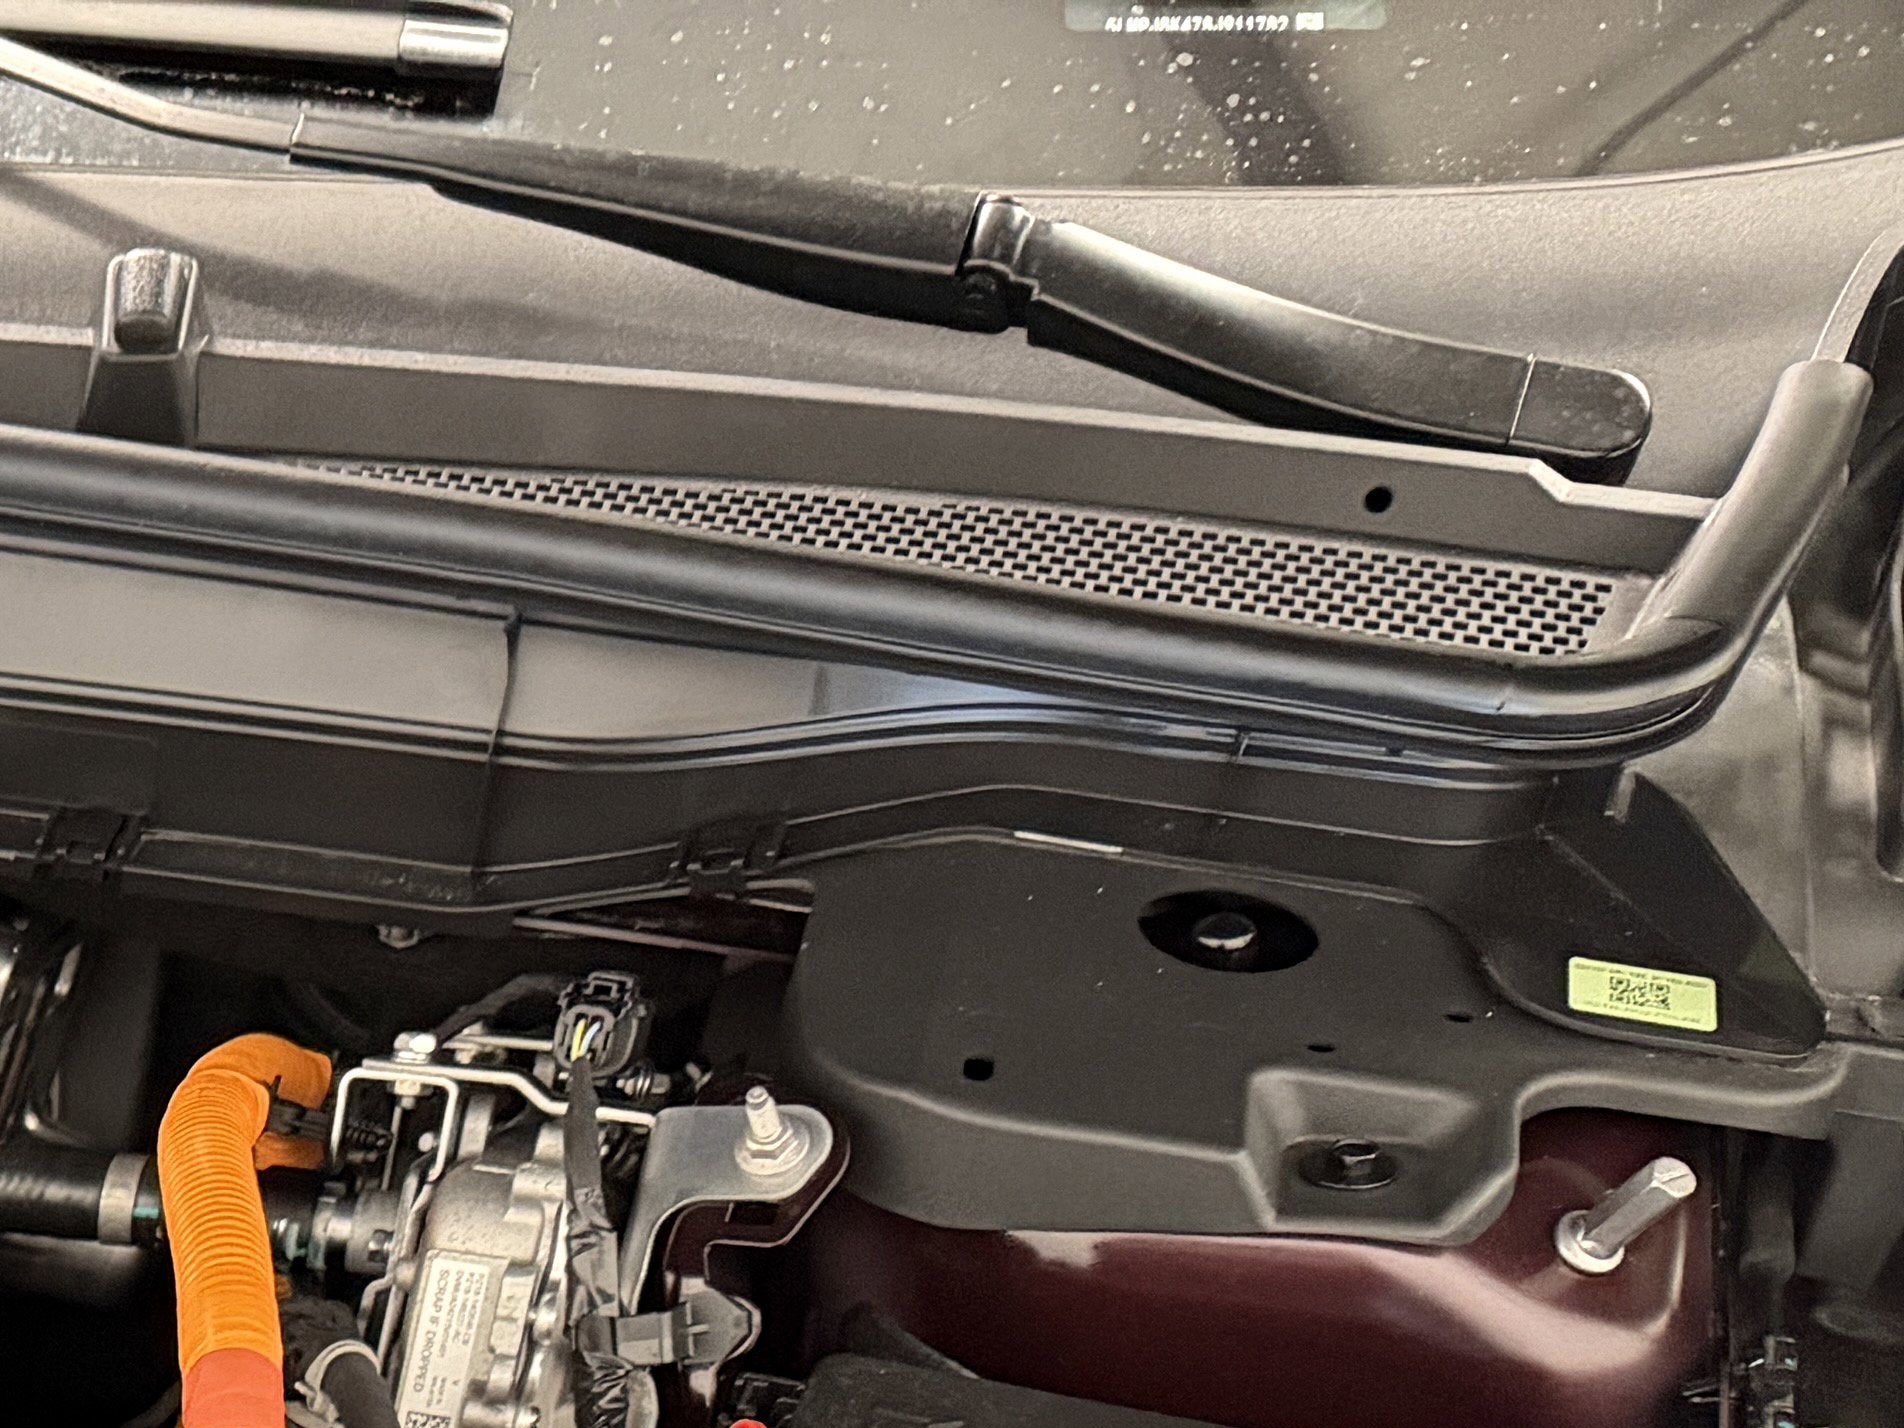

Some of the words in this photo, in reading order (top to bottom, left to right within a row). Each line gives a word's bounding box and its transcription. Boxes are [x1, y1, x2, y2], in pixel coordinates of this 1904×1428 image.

[431, 1268, 449, 1312] SCRAP
[428, 1315, 439, 1326] IF
[412, 1329, 435, 1393] DROPPED
